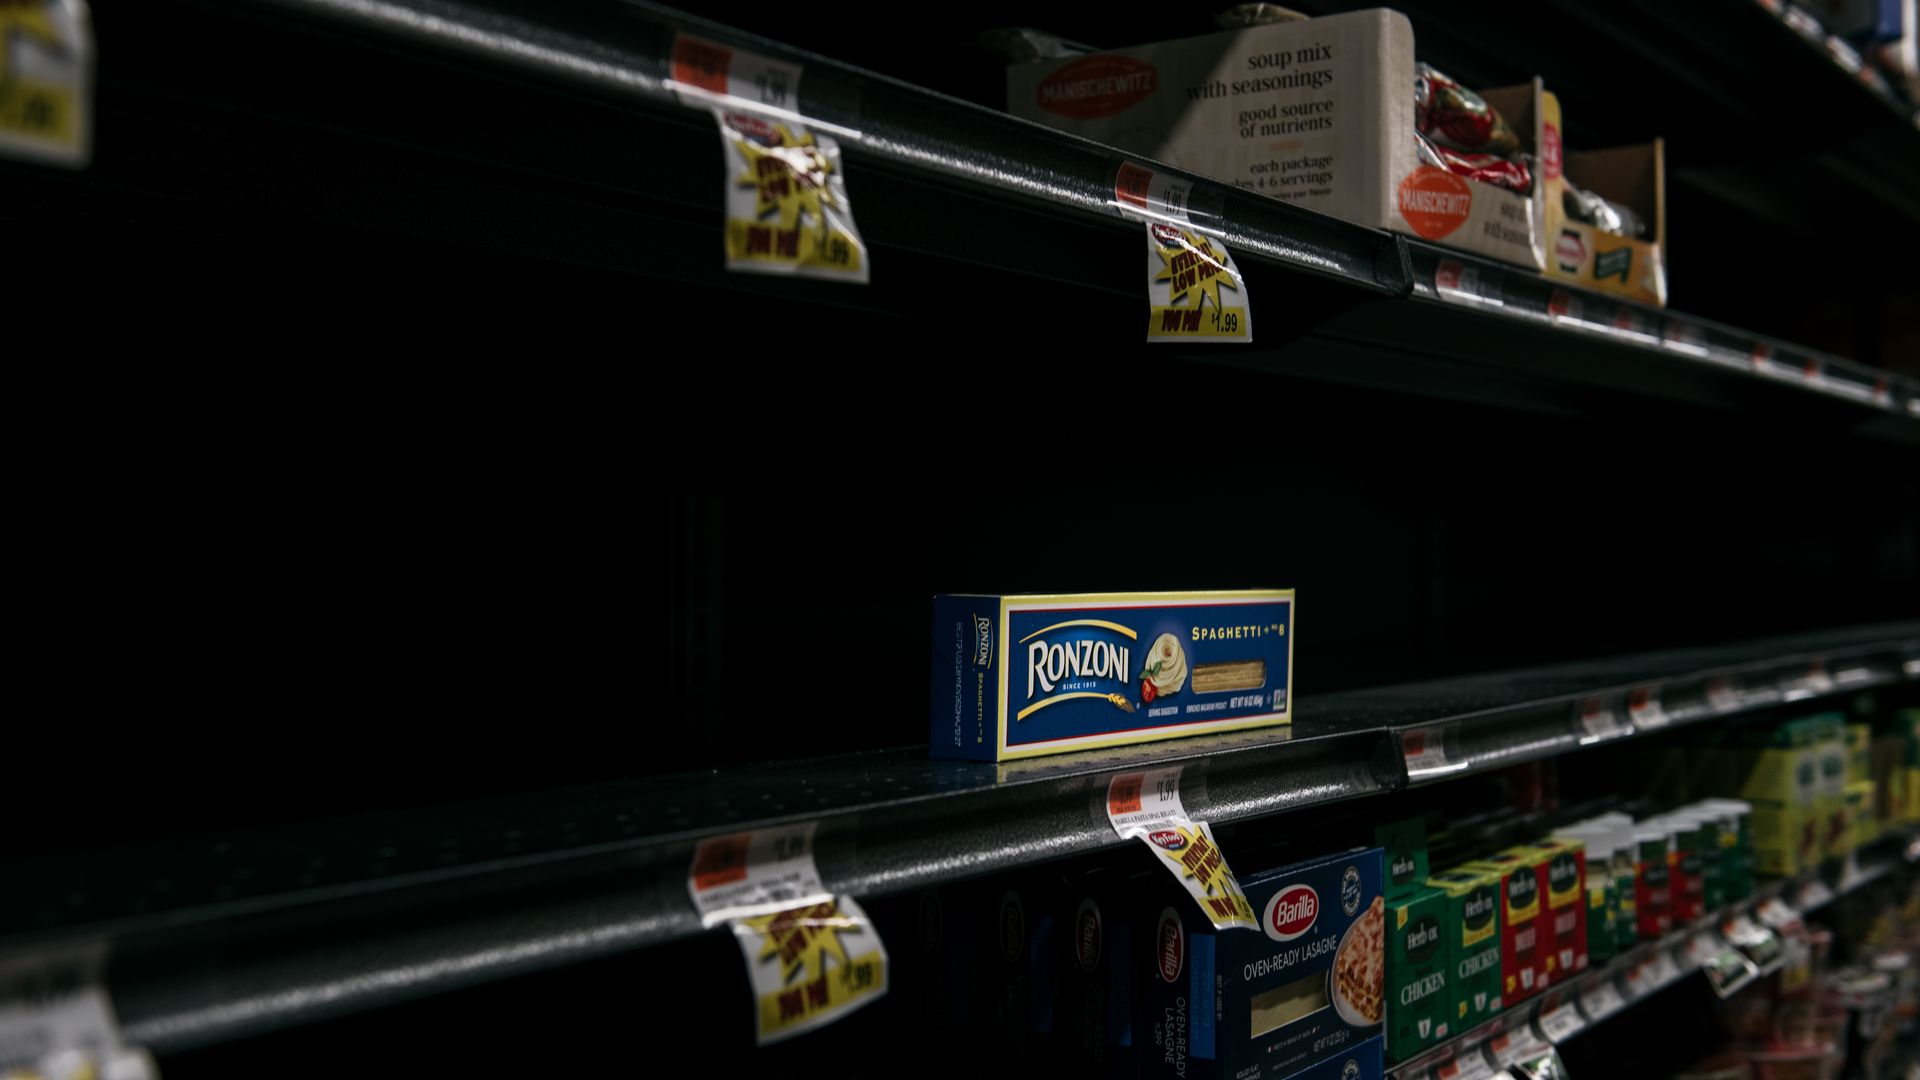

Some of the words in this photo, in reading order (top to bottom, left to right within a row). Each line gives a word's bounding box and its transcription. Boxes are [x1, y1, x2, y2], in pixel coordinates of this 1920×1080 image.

[1248, 51, 1291, 70] soup
[1297, 43, 1332, 63] mix
[1042, 71, 1152, 104] MANISCHEWITZ
[1186, 80, 1227, 100] with
[1232, 69, 1332, 96] seasonings
[1240, 105, 1277, 126] good
[1281, 100, 1334, 117] source
[1241, 122, 1257, 139] of
[1261, 116, 1332, 137] nutrients
[1250, 159, 1279, 173] each
[1281, 155, 1333, 173] package
[1280, 171, 1333, 186] servings
[1400, 188, 1470, 217] MANISCHEWITZ
[1173, 272, 1196, 294] LOW
[1162, 310, 1182, 332] YOU
[1182, 310, 1202, 332] PAY
[1211, 312, 1238, 333] $1.99
[977, 616, 990, 667] RONZONI
[1192, 626, 1262, 641] SPAGHETTI
[1279, 623, 1286, 636] 8
[1027, 640, 1129, 700] RONZONI
[1062, 683, 1081, 691] SINCE
[1277, 894, 1316, 927] Barilla
[1164, 924, 1178, 977] Barilla
[1244, 949, 1300, 982] OVEN-READY
[1301, 934, 1338, 961] LASAGNE
[1458, 947, 1499, 980] CHICKEN
[1400, 969, 1446, 1006] CHICKEN
[1164, 1007, 1175, 1065] LASAGNE
[1175, 996, 1186, 1079] OVEN-READY
